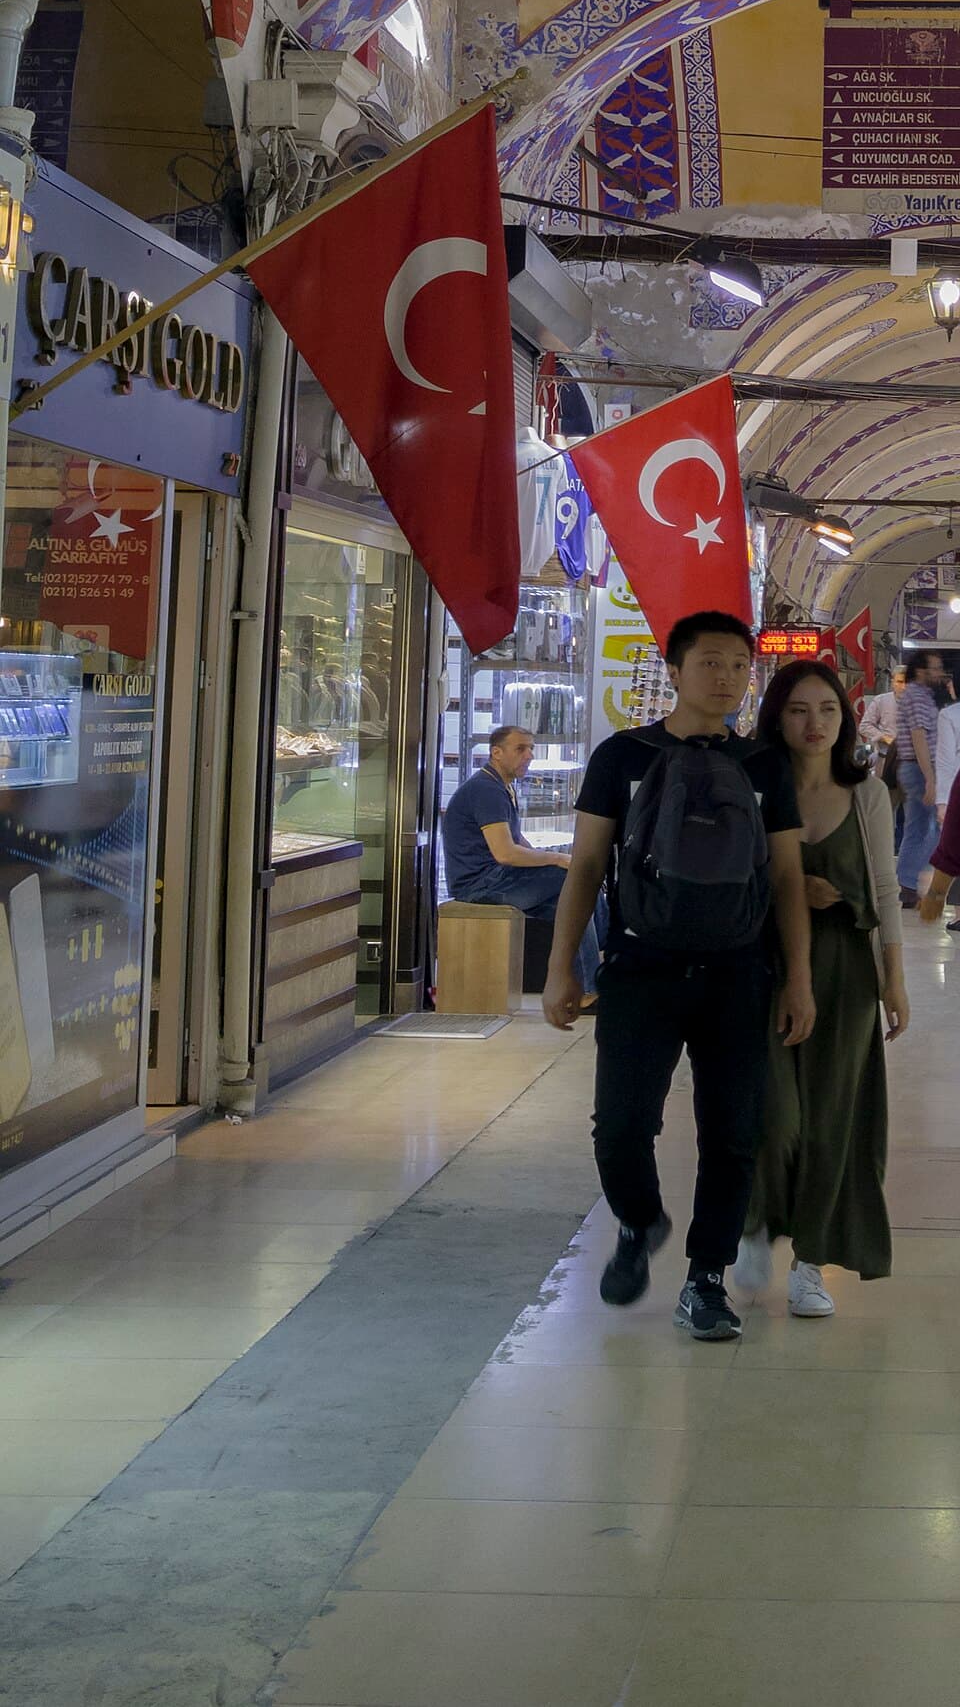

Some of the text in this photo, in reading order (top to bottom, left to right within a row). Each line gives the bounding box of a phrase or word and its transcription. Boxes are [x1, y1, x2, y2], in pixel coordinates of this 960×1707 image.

[853, 69, 897, 83] AĞA SK.
[853, 89, 934, 103] UNCUOĞLU SK.
[917, 112, 935, 124] SK.
[852, 133, 942, 145] ÇUHACI HANI SK.
[852, 154, 956, 165] KUYUMCULAR CAD.
[852, 172, 899, 185] CEVAHİR
[154, 312, 244, 414] GOLD
[536, 476, 552, 525] 7
[557, 497, 580, 540] 9
[27, 538, 71, 551] ALTIN
[75, 538, 87, 551] &
[99, 574, 115, 584] 74
[118, 574, 132, 584] 79
[43, 587, 134, 599] (0212) 526 51 49
[125, 675, 152, 696] GOLD
